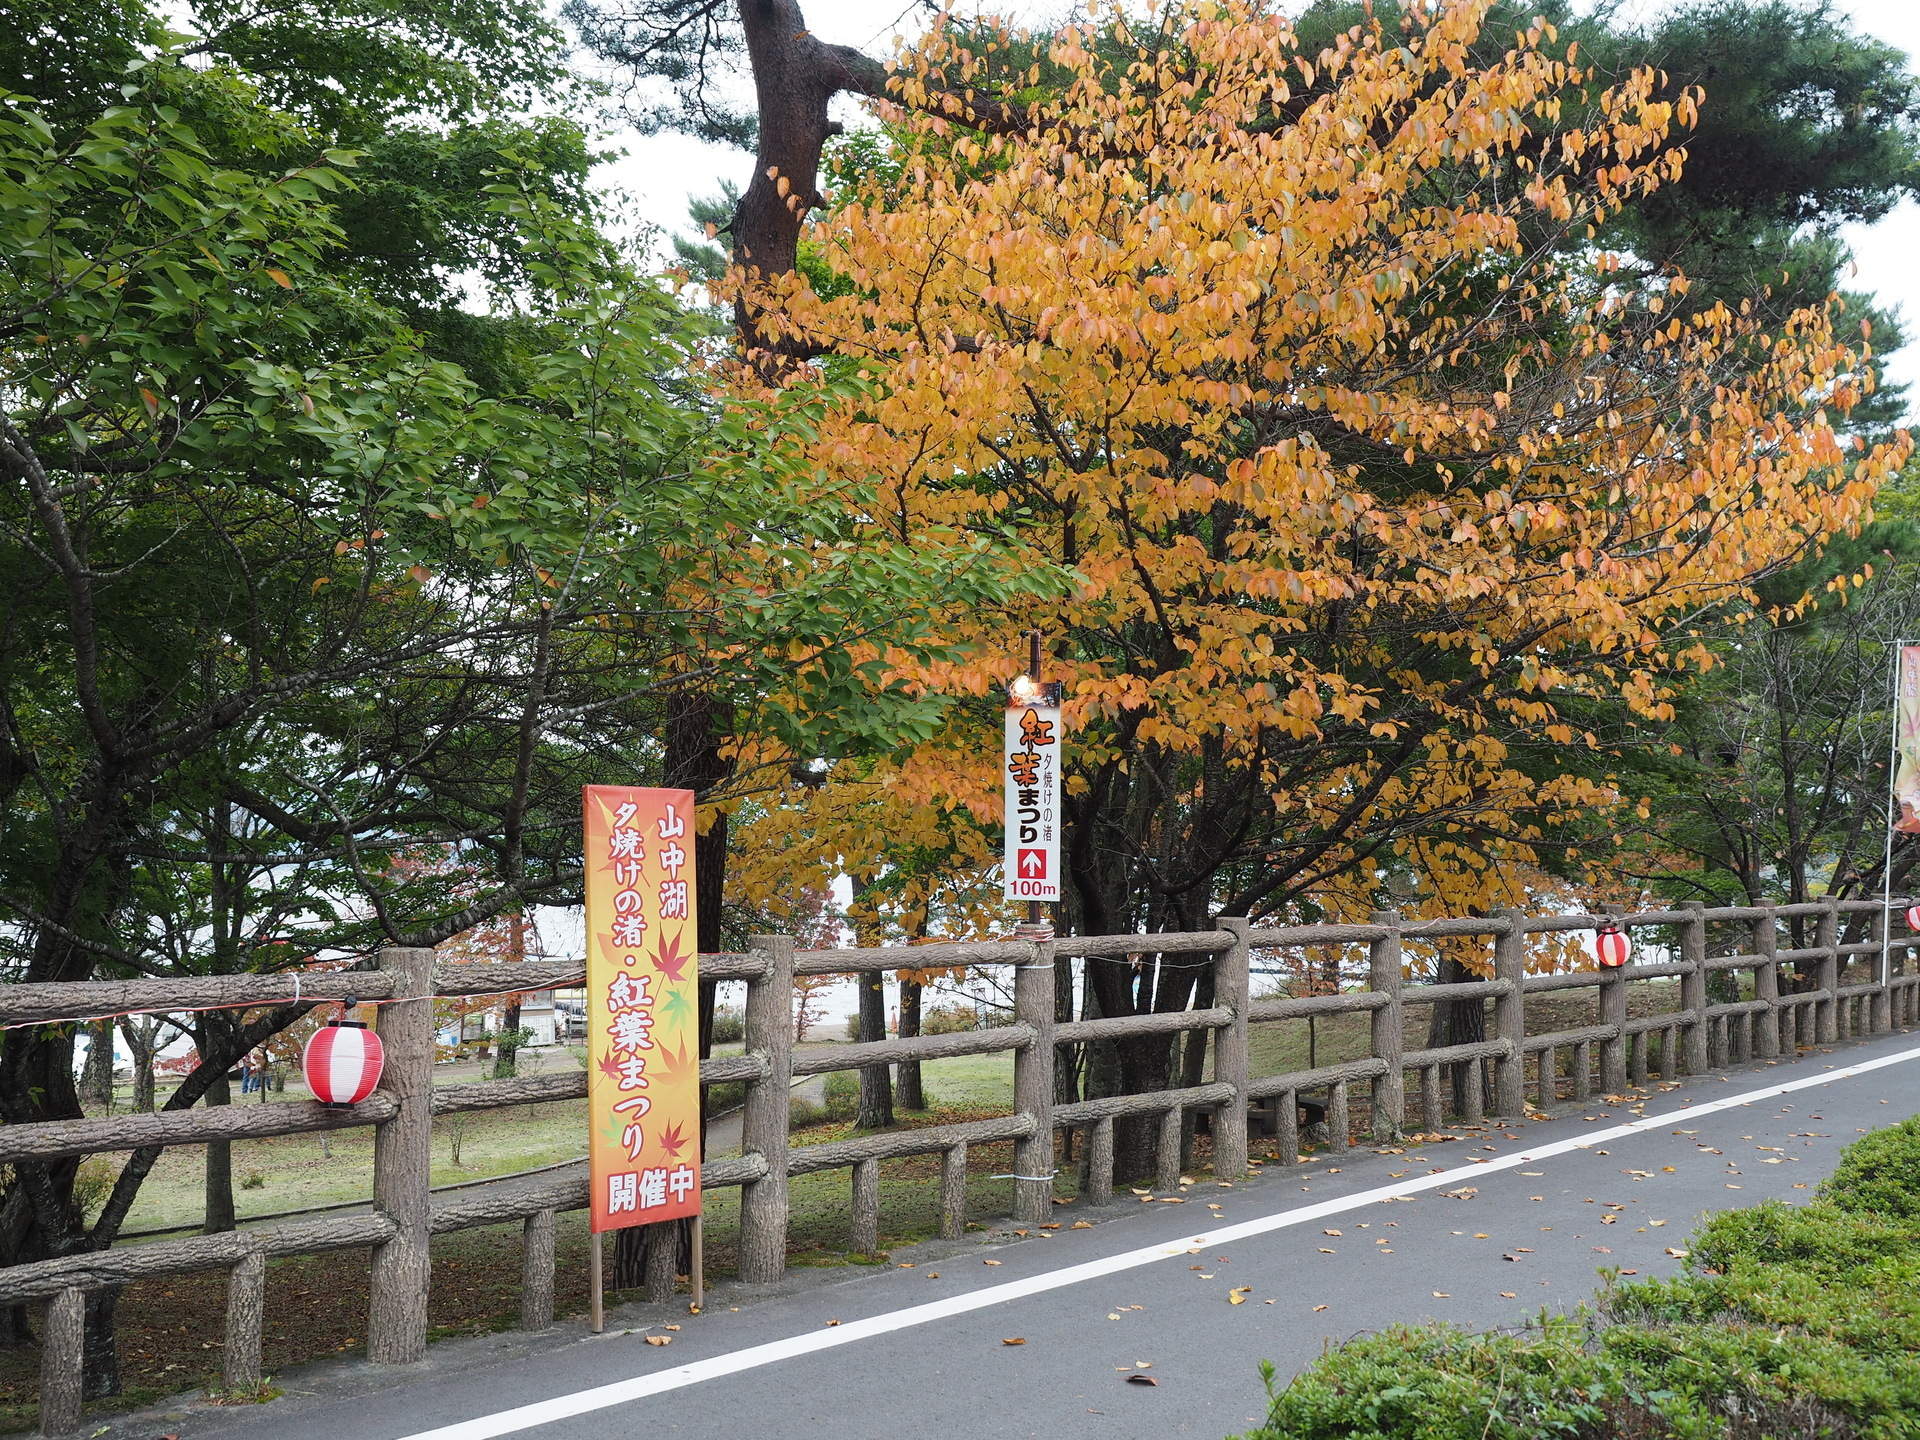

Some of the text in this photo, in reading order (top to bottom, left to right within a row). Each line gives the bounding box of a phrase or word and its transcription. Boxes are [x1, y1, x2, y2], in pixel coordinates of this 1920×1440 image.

[1009, 709, 1055, 843] 紅葉まつり
[1043, 753, 1053, 841] 夕焼けの渚
[658, 803, 688, 920] 山中湖
[1010, 881, 1056, 896] 100m
[608, 803, 653, 1161] 夕焼けの渚・紅葉まつり
[608, 1165, 694, 1213] 開催中
